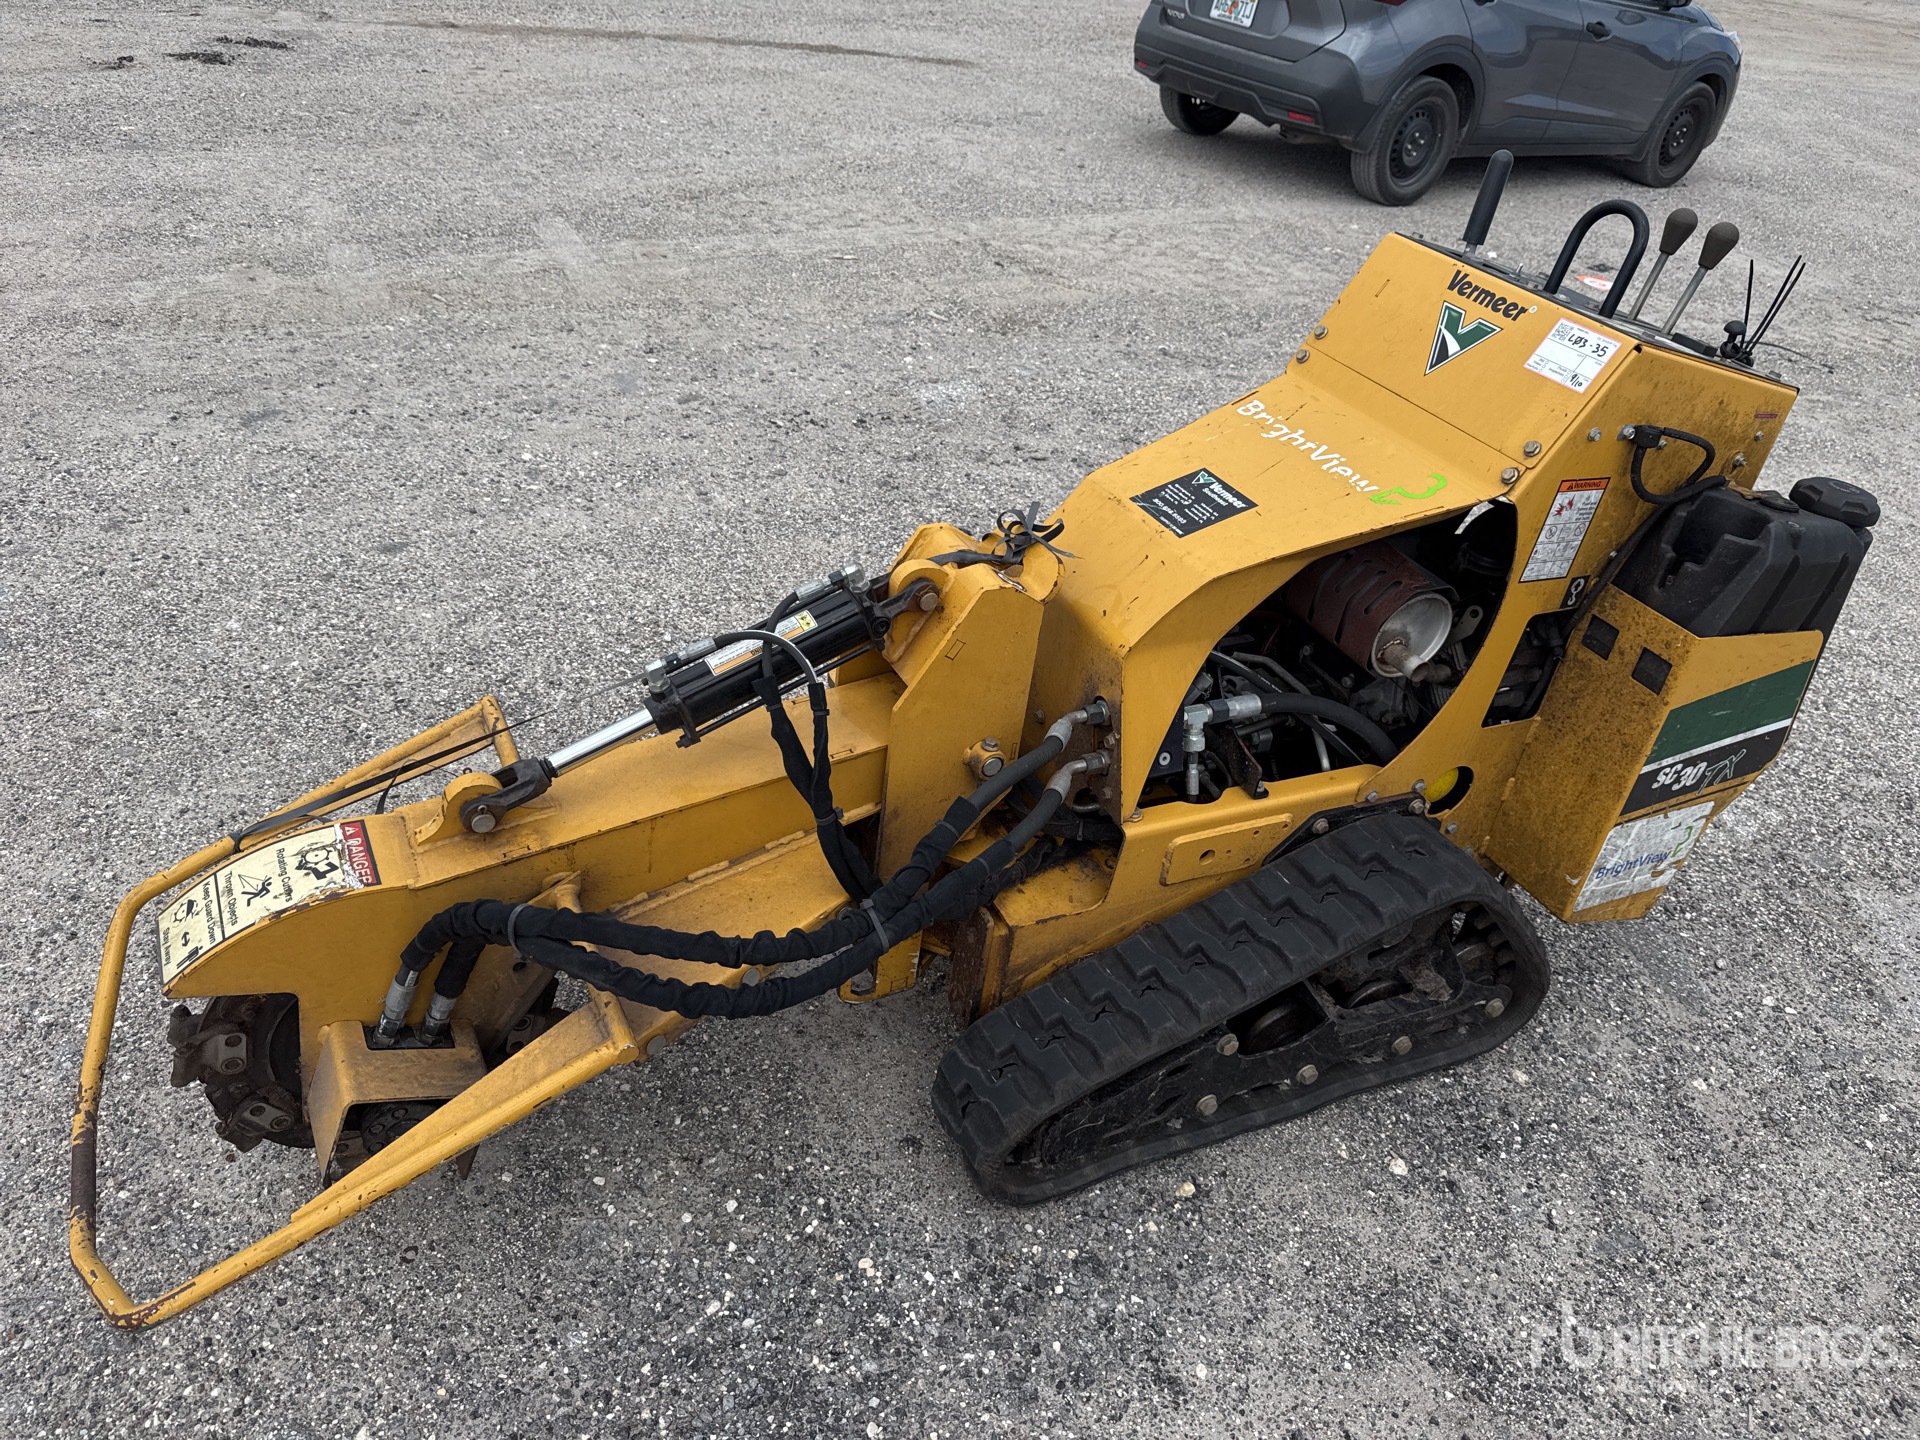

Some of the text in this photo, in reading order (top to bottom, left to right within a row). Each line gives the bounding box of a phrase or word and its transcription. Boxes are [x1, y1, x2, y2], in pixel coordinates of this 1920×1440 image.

[1447, 269, 1529, 321] Vermeer
[1236, 399, 1380, 492] BrightView
[1202, 487, 1229, 507] Southeast
[1209, 481, 1248, 509] Vermeer
[1574, 480, 1602, 490] WARNING
[276, 847, 294, 903] Rotating Cutters
[1595, 850, 1672, 880] BrightView
[202, 880, 216, 945] Keep Guard Down
[224, 870, 239, 926] Thrown Objects
[162, 926, 172, 967] Stay Away
